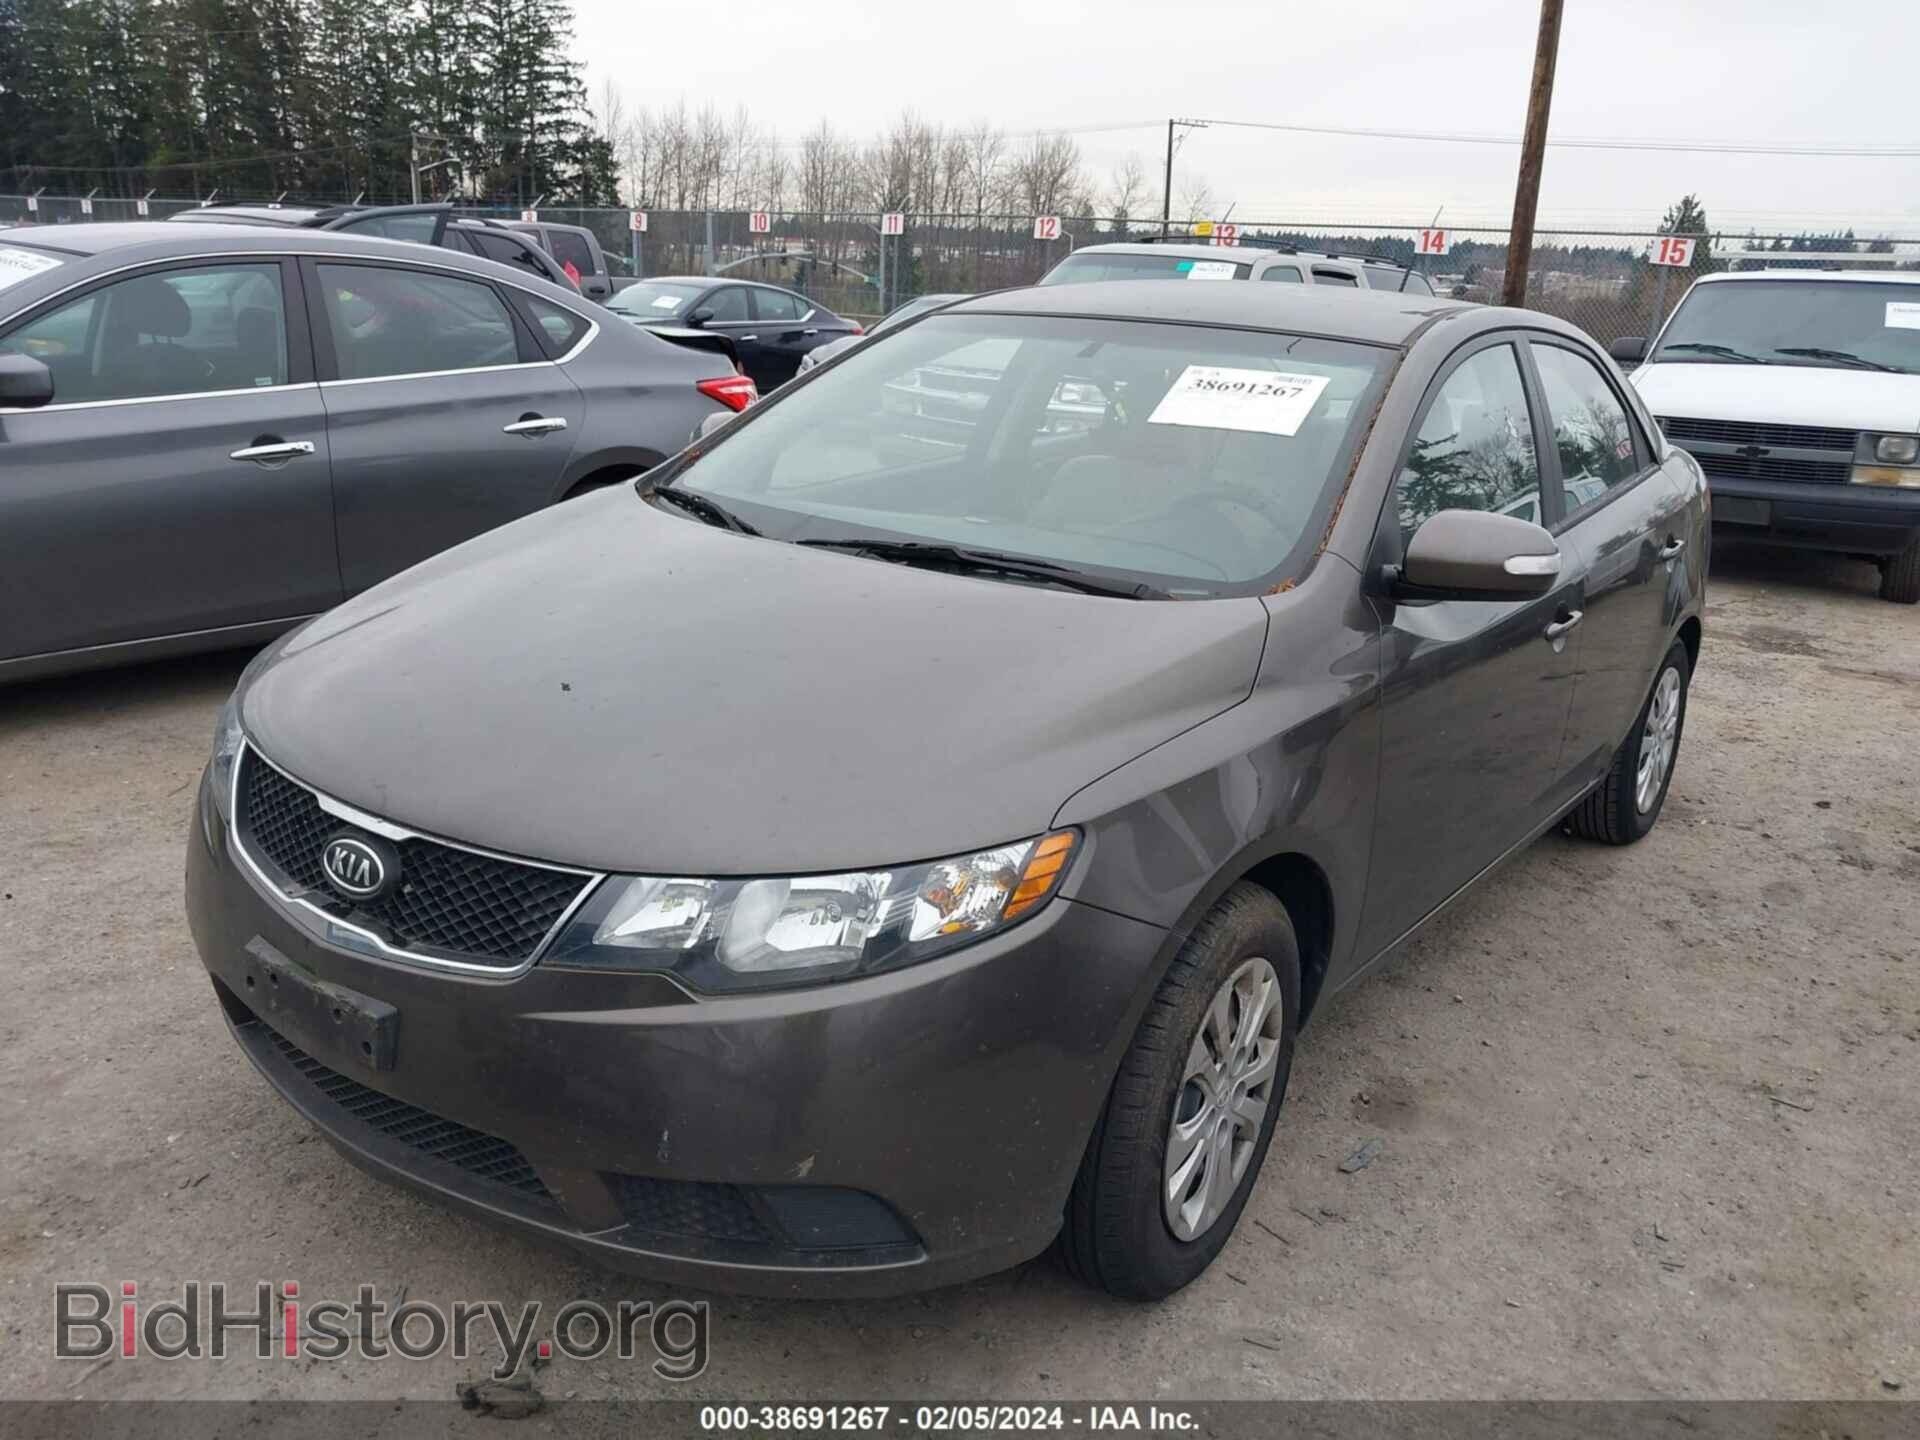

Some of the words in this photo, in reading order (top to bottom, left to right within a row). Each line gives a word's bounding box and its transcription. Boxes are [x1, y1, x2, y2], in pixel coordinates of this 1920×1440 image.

[634, 214, 643, 229] 9
[752, 213, 768, 231] 10
[887, 215, 899, 233] 11
[1039, 218, 1056, 238] 12
[1215, 225, 1236, 246] 13
[1421, 230, 1445, 253] 14
[1659, 238, 1688, 264] 15
[1187, 378, 1303, 398] 38691267
[332, 846, 370, 886] KIA
